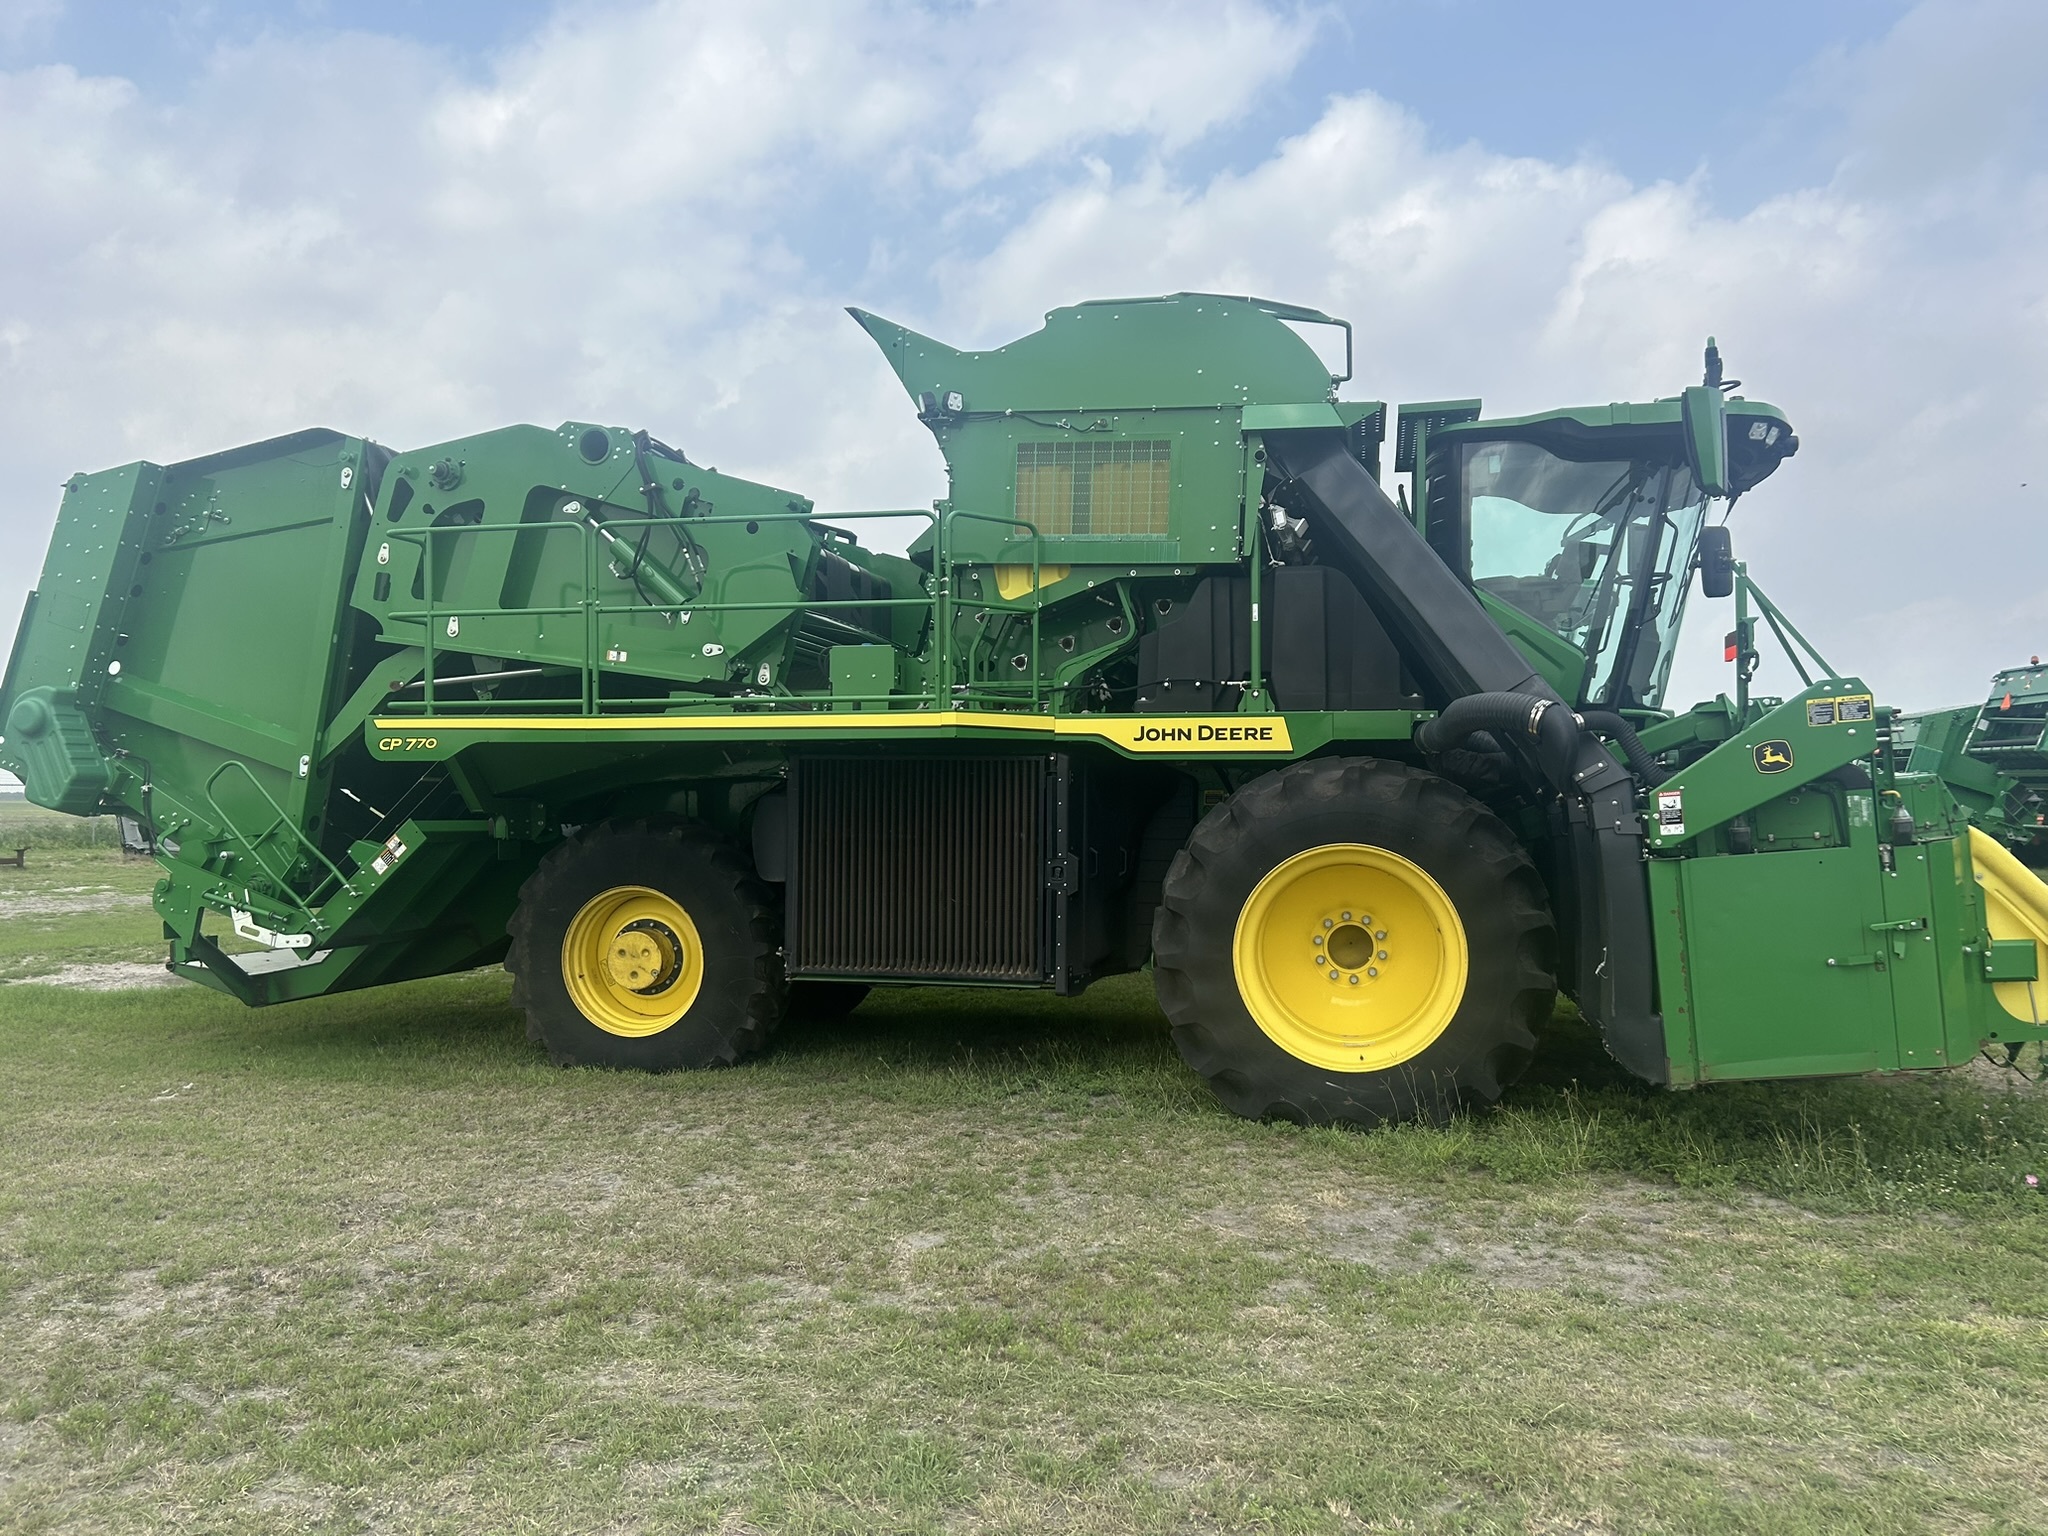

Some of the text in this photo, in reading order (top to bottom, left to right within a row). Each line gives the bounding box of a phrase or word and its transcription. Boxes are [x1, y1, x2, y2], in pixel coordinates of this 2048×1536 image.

[1133, 725, 1273, 741] JOHN DEERE
[378, 737, 438, 752] CP 770
